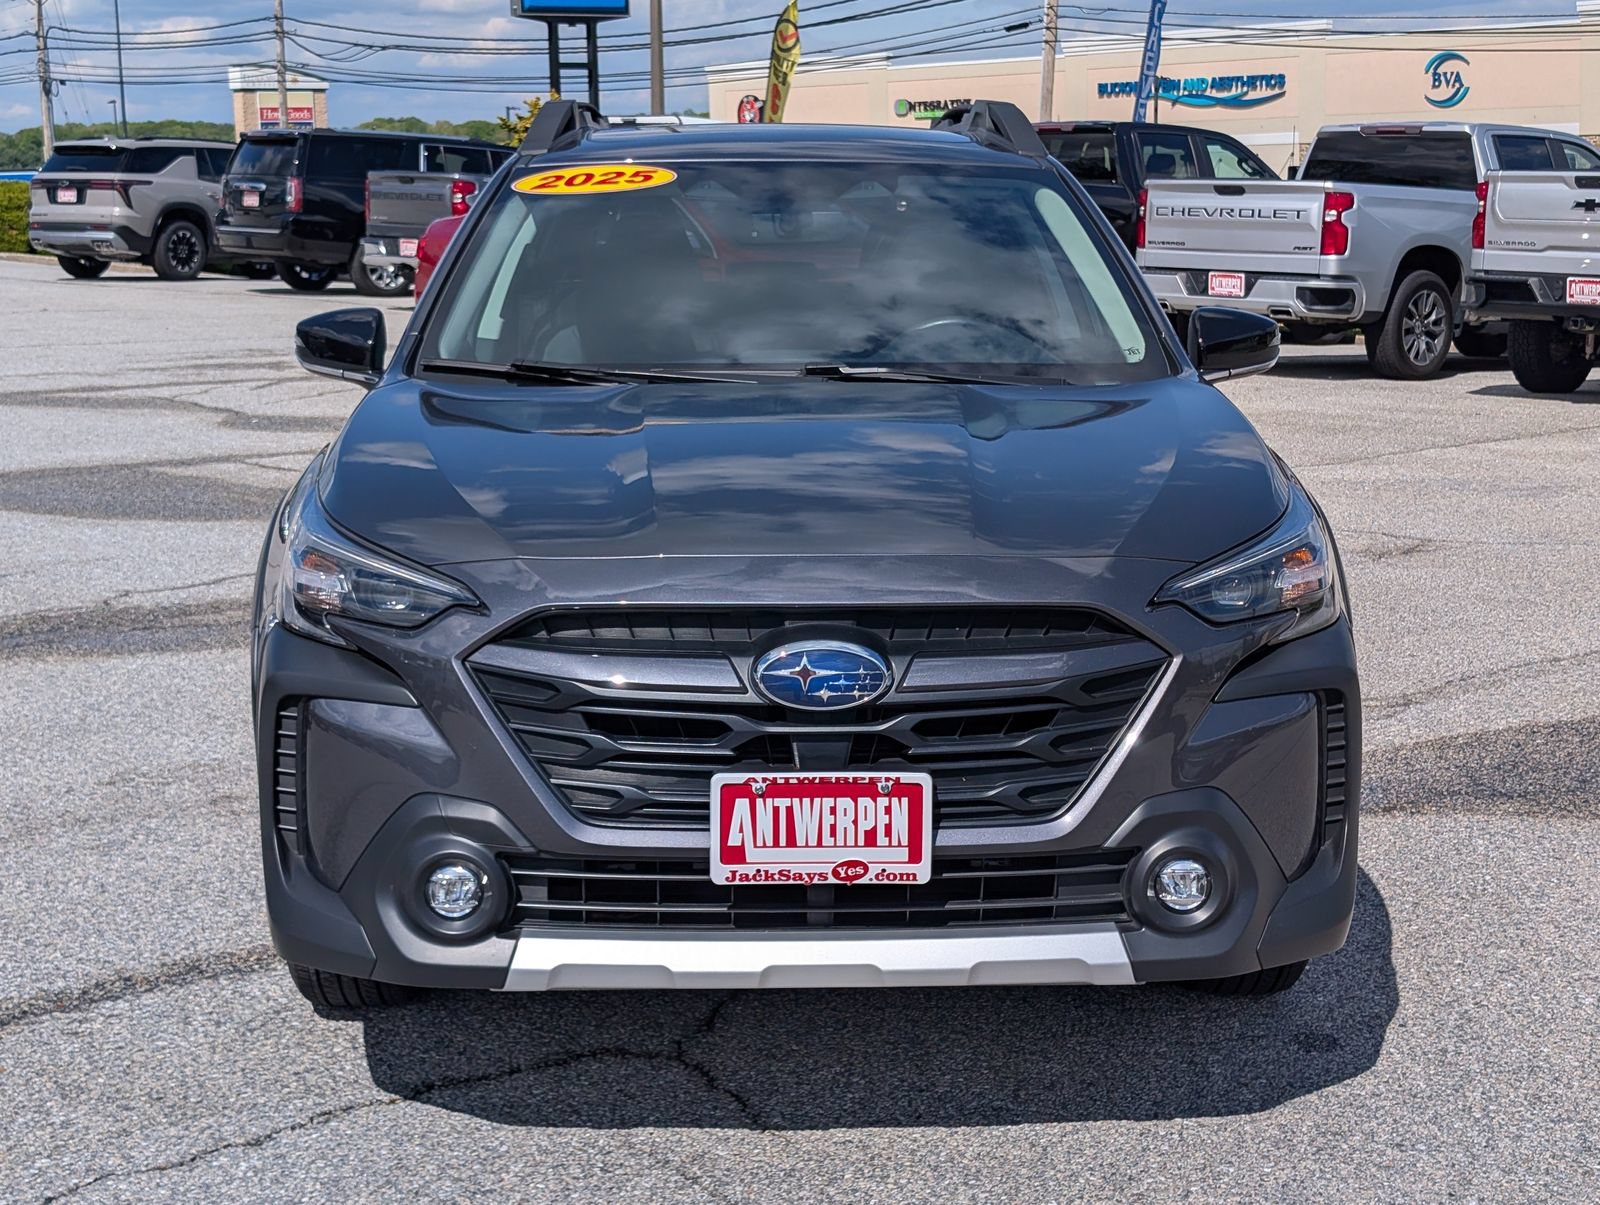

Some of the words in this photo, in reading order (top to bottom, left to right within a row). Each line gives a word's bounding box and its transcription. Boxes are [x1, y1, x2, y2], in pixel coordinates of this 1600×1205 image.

[1183, 77, 1208, 93] AND
[1209, 73, 1286, 92] AESTHETICS
[1431, 71, 1464, 90] BVA
[530, 170, 658, 190] 2025
[1155, 207, 1308, 220] CHEVROLET
[1211, 277, 1241, 289] ANTWERPEN
[727, 797, 909, 862] ANTWERPEN
